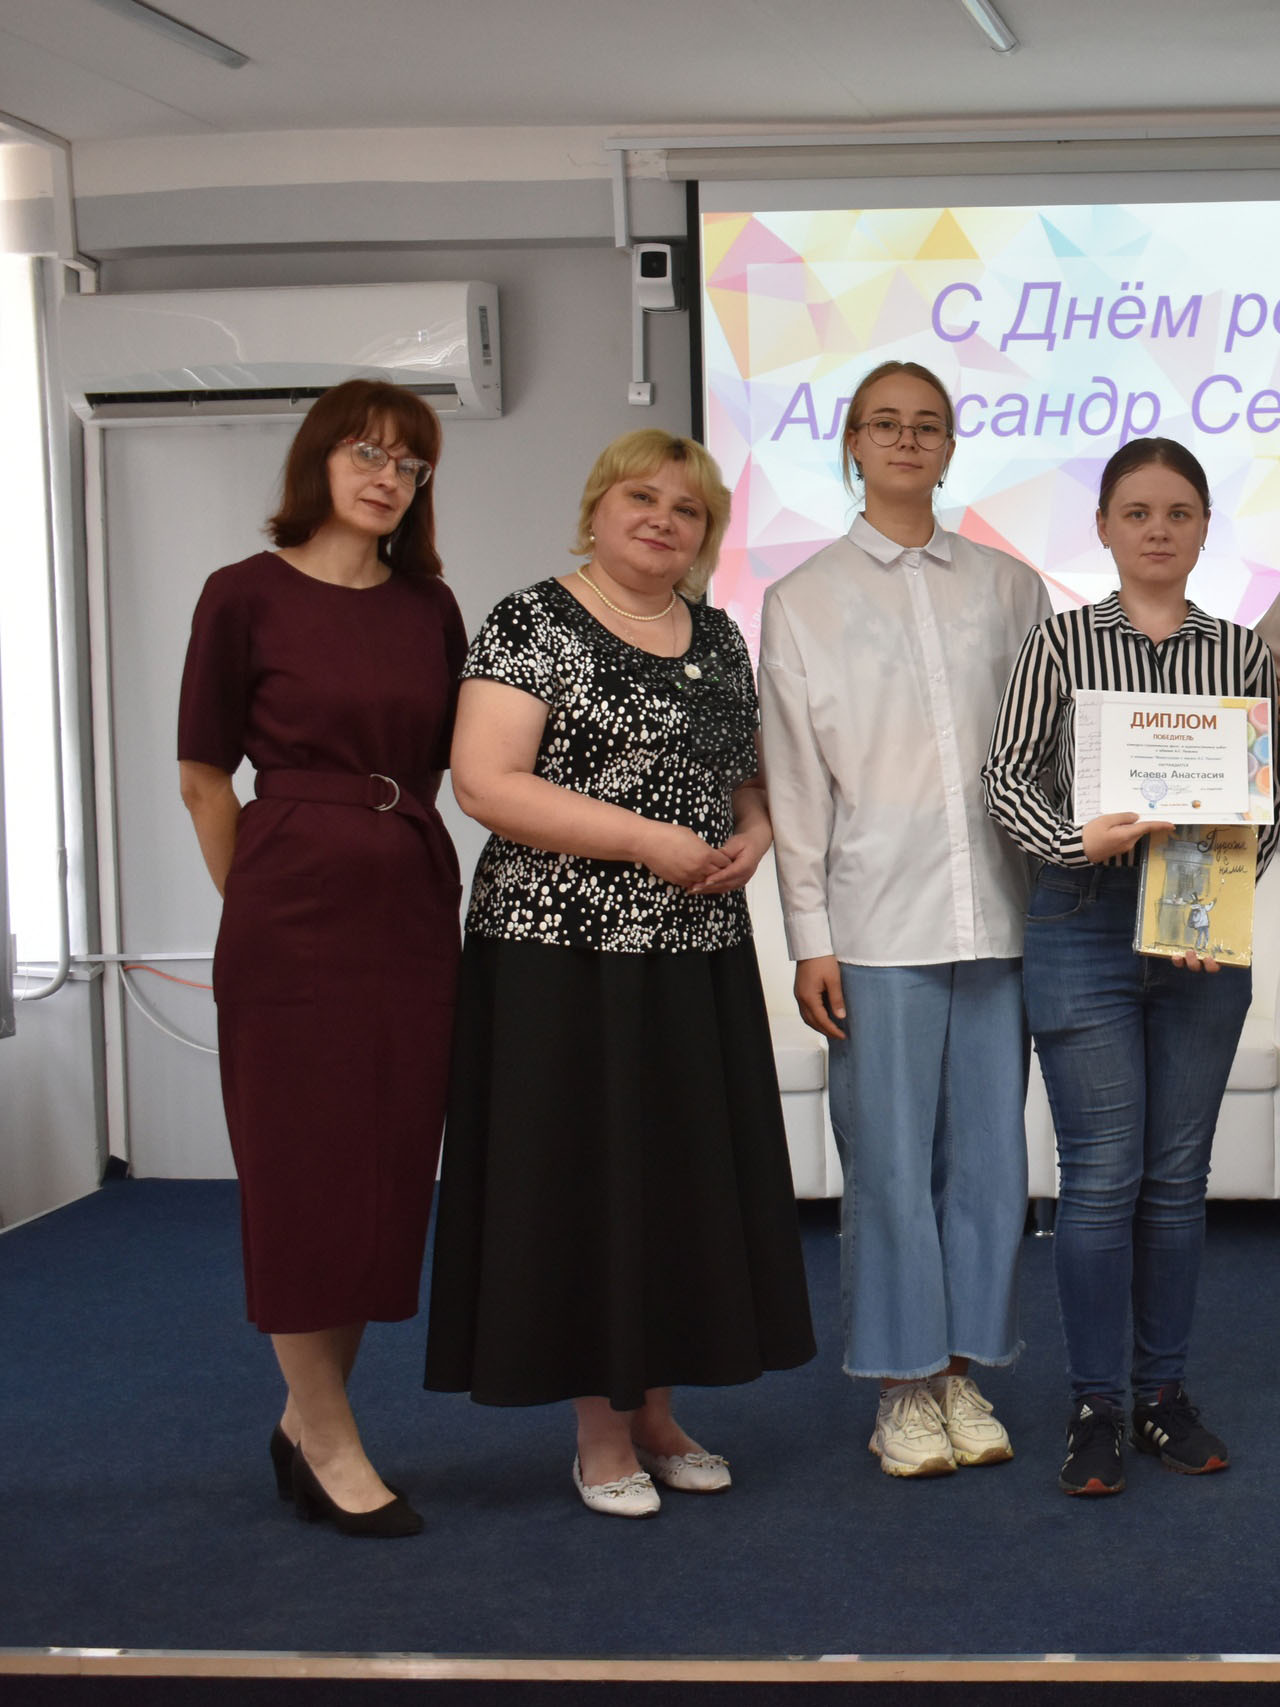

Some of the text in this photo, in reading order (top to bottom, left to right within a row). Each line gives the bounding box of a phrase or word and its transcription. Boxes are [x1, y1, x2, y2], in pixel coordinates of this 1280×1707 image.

[933, 283, 983, 342] С
[1001, 280, 1202, 351] Днём
[770, 375, 1162, 449] Алсандр
[1130, 711, 1217, 730] ДИПЛОМ
[1153, 733, 1194, 741] ПОБЕДИТЕЛЬ
[1129, 769, 1225, 779] Исаева Анастасия
